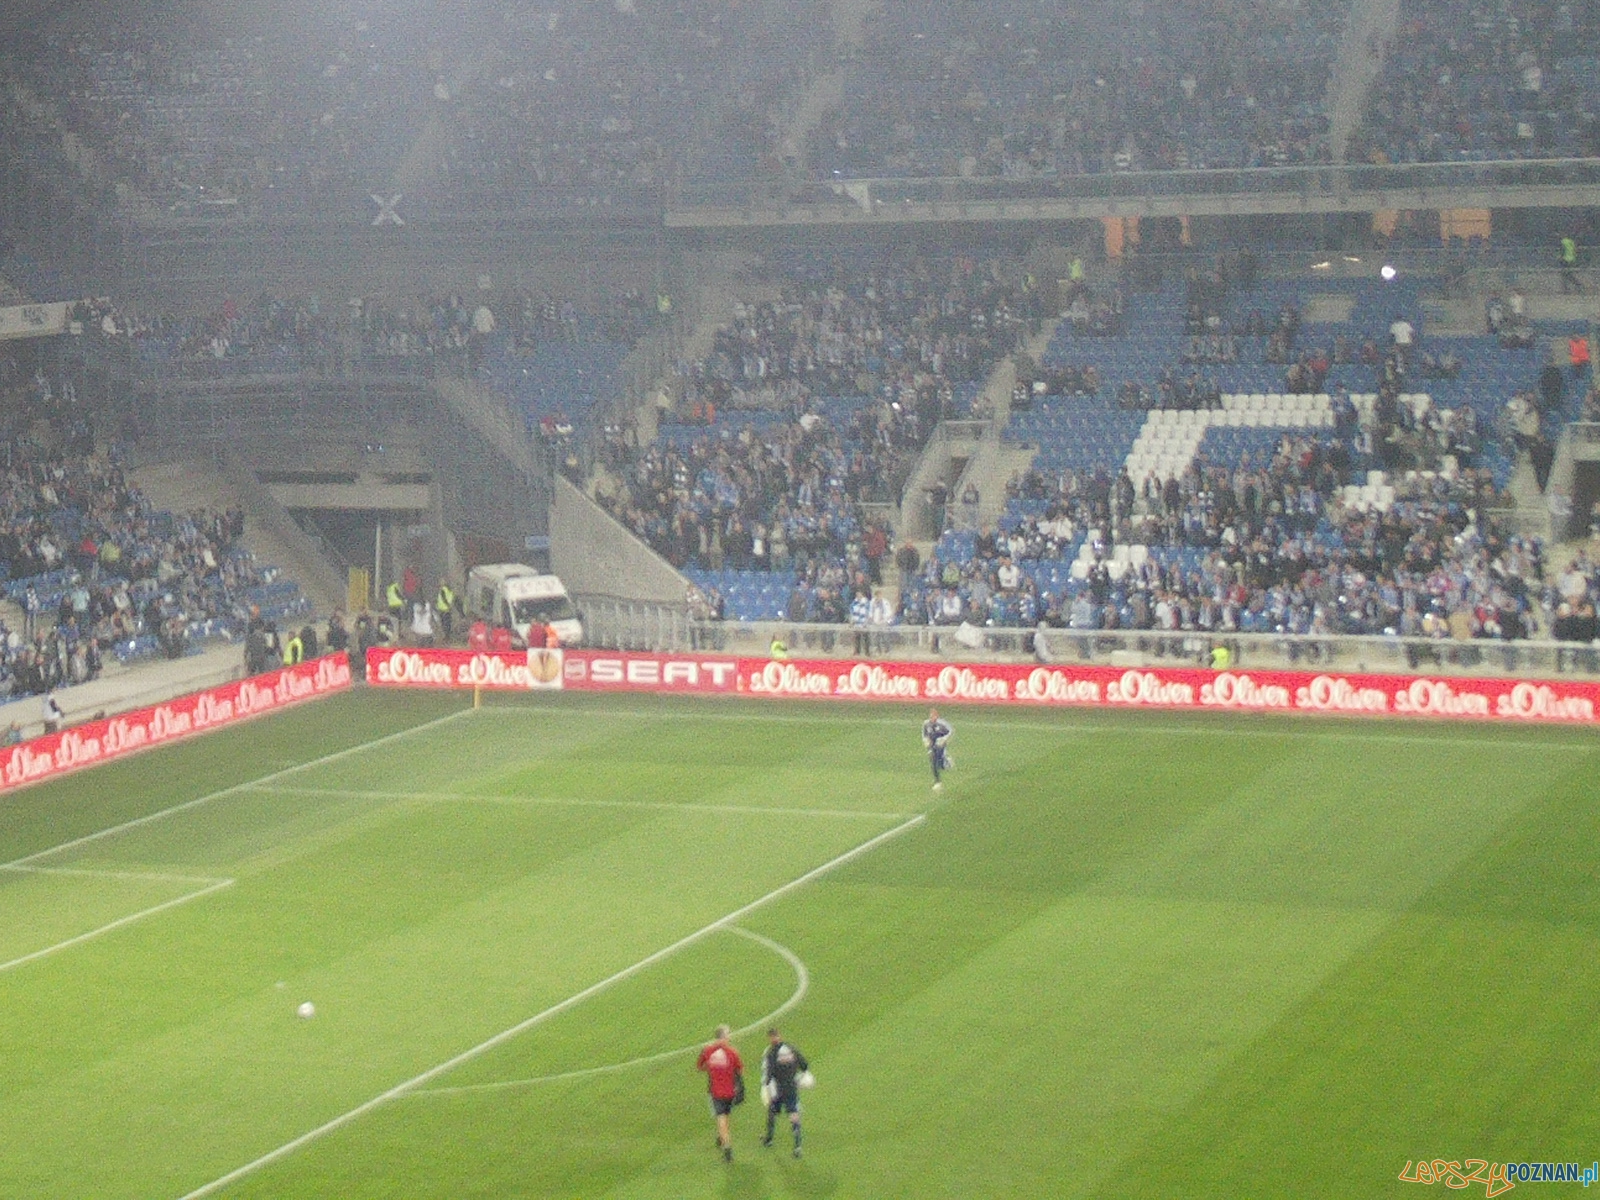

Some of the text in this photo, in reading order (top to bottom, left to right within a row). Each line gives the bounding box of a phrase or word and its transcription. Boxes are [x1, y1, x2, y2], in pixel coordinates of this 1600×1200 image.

[379, 652, 451, 682] s.Oliver
[590, 659, 736, 685] SEAT
[750, 660, 1595, 719] s.Oliver s.Oliver s.Oliver s.Oliver s.Oliver s.Oliver s.Oliver s.Oliver s.Oliver
